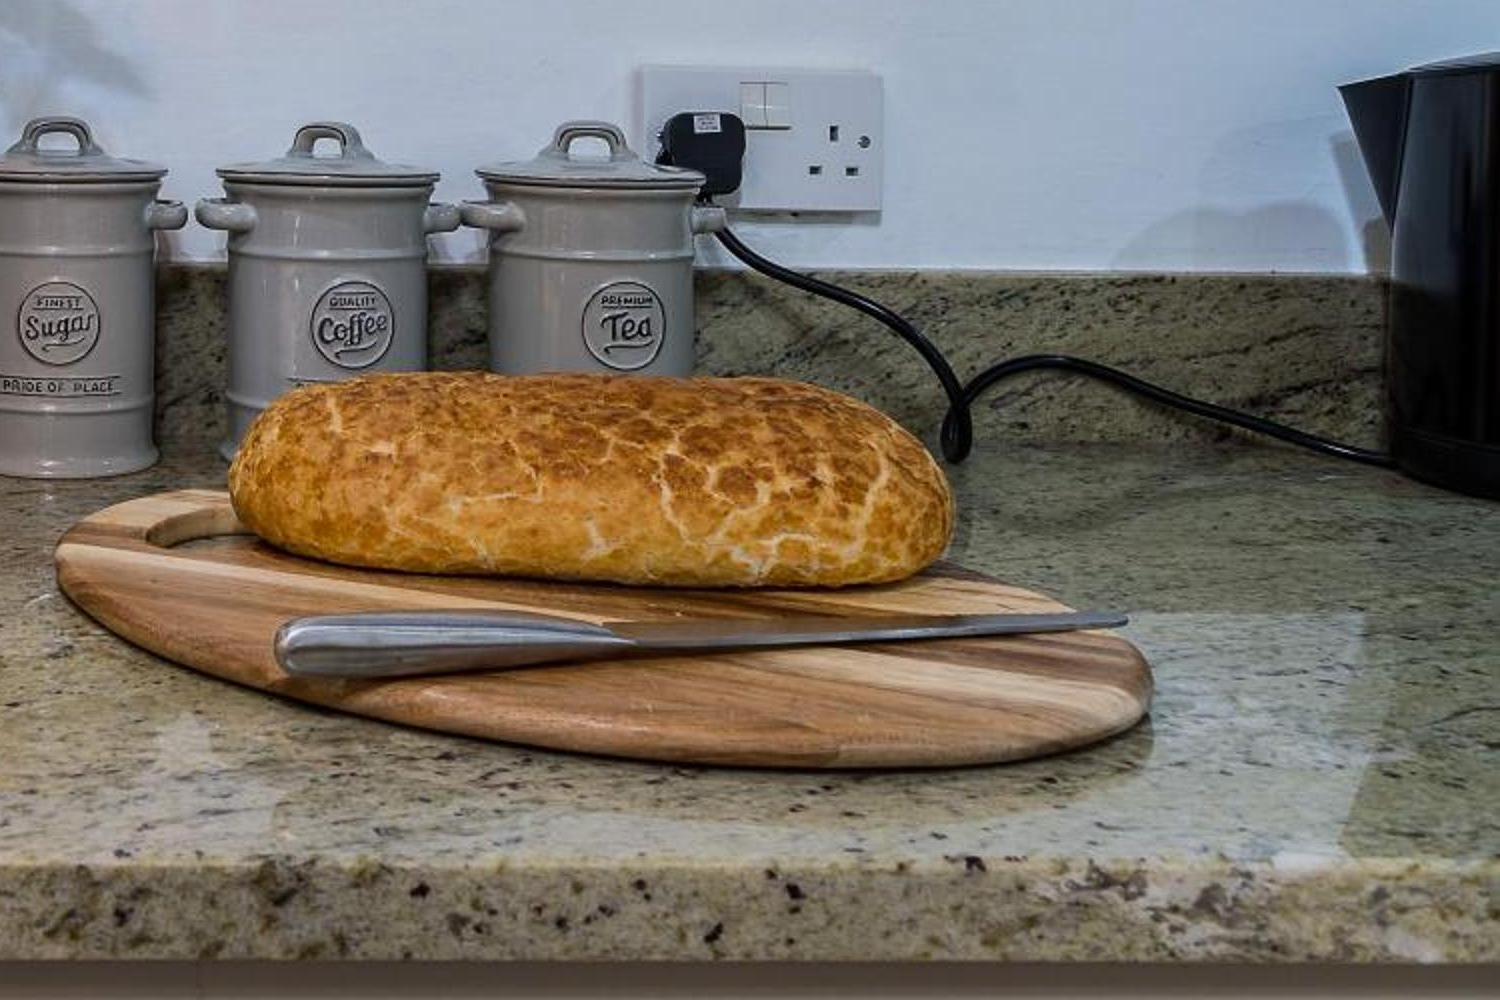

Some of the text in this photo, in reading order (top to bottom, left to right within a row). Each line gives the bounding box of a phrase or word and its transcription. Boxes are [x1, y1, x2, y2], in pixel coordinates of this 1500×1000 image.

[36, 299, 80, 307] FINEST
[329, 297, 376, 307] QUALITY
[600, 296, 654, 305] PREMIUM
[25, 314, 95, 342] Sugar
[318, 311, 388, 347] Coffee
[600, 311, 653, 341] Tea
[3, 379, 115, 393] PRIDE OF PLACE
